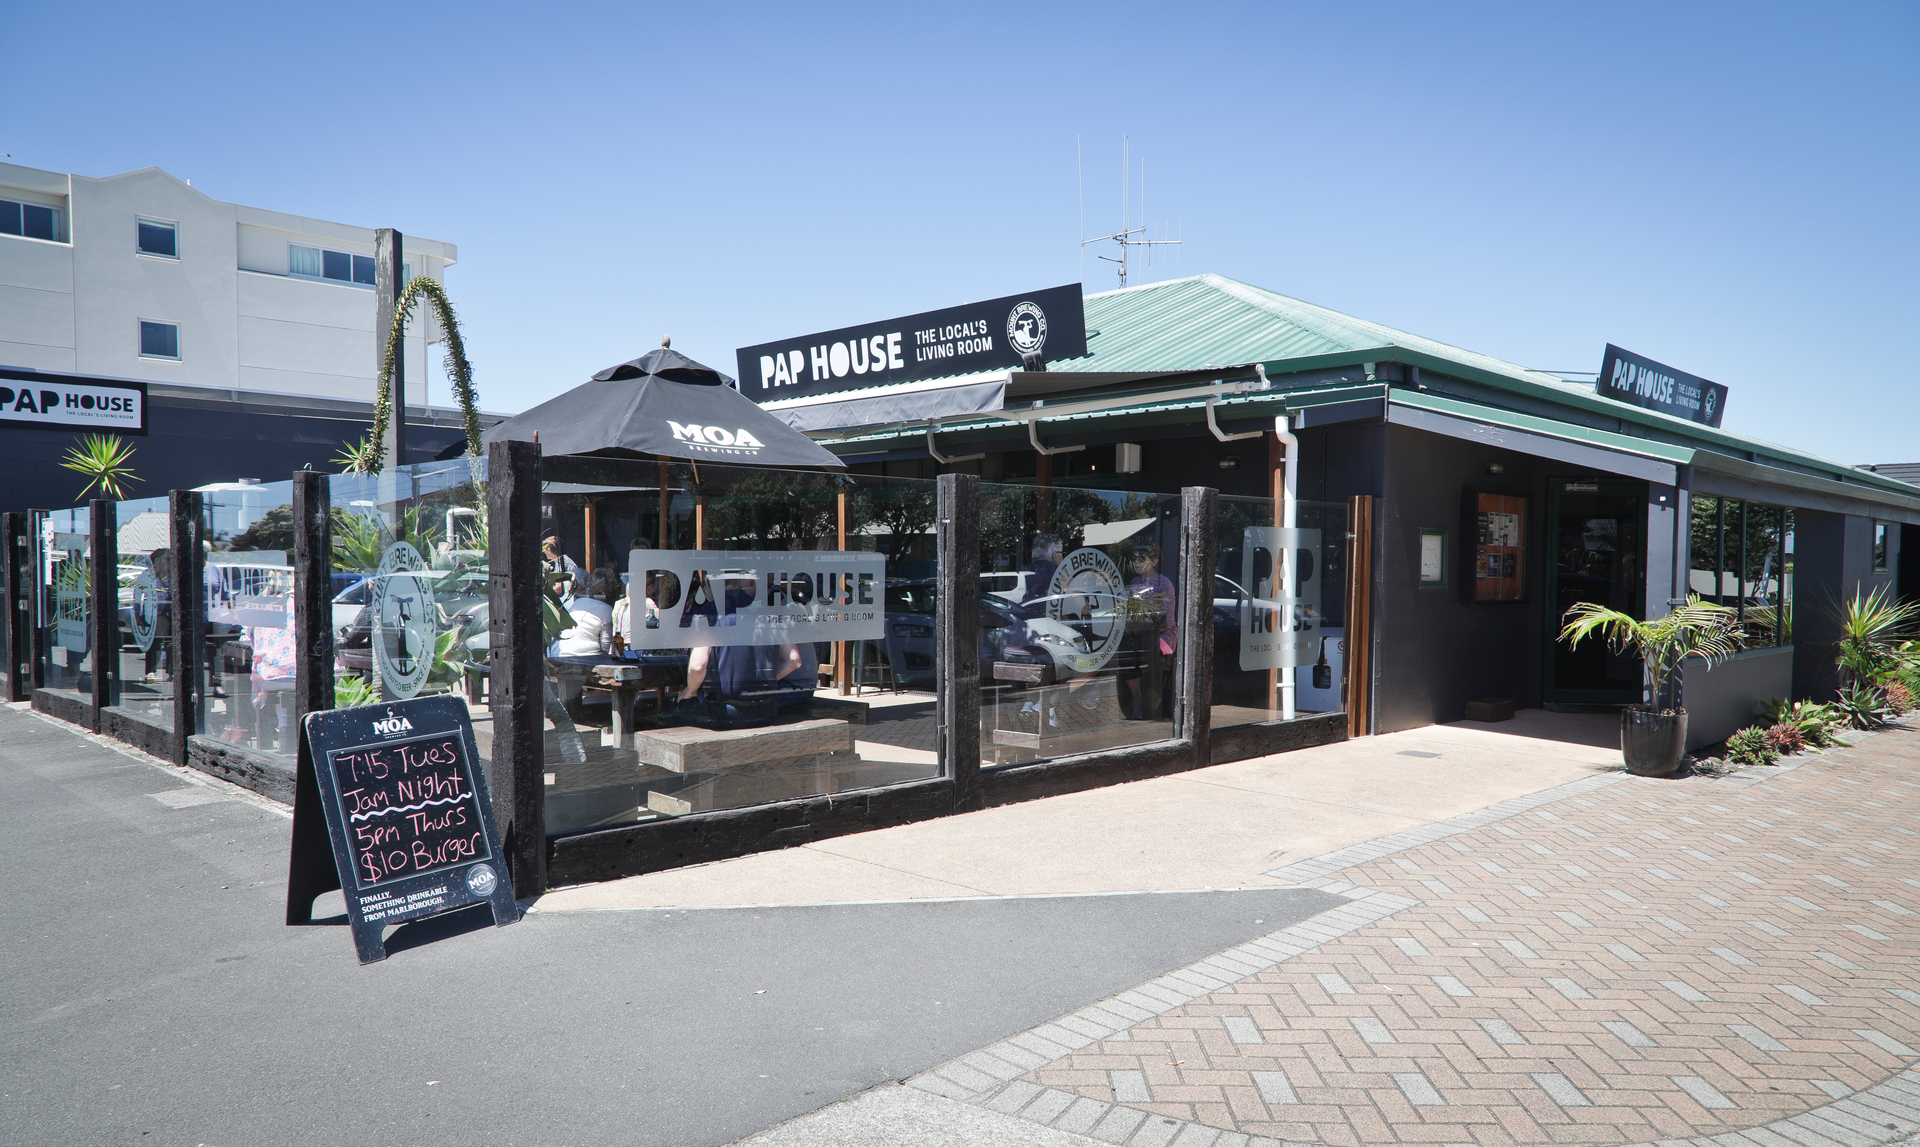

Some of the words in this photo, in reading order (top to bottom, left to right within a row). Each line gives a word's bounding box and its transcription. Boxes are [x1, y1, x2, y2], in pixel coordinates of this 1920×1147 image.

[915, 329, 937, 345] THE
[939, 320, 988, 341] LOCAL'S
[1009, 310, 1018, 337] MOUNT
[1016, 304, 1042, 318] BREWING
[760, 350, 805, 389] PAP
[810, 332, 904, 381] HOUSE
[916, 343, 955, 362] LIVING
[957, 336, 993, 356] ROOM
[1611, 358, 1636, 391] PAP
[1635, 366, 1675, 404] HOUSE
[1678, 382, 1686, 394] THE
[0, 386, 60, 414] PAP
[65, 393, 134, 412] HOUSE
[1676, 394, 1689, 407] LIVING
[1689, 398, 1701, 410] ROOM
[666, 420, 765, 448] MOA
[689, 444, 741, 455] BREWING
[1071, 552, 1120, 588] BREWING
[1252, 546, 1314, 599] PAP
[59, 597, 83, 622] HOUSE
[645, 569, 756, 629] PAP
[767, 572, 874, 607] HOUSE
[1250, 604, 1314, 635] HOUSE
[401, 683, 412, 692] BEER
[372, 717, 414, 735] MOA
[336, 750, 389, 782] 7:15
[393, 742, 457, 774] Tues
[343, 788, 389, 814] Jam
[398, 767, 463, 803] Night
[405, 806, 467, 836] Thurs
[361, 850, 407, 883] $10
[412, 832, 480, 870] Burger
[468, 871, 495, 889] MOA
[360, 891, 392, 905] FINALLY,
[361, 896, 406, 914] SOMETHING
[406, 886, 448, 902] DRINKABLE
[364, 911, 386, 922] FROM
[387, 897, 445, 916] MARLBOROUGH.
